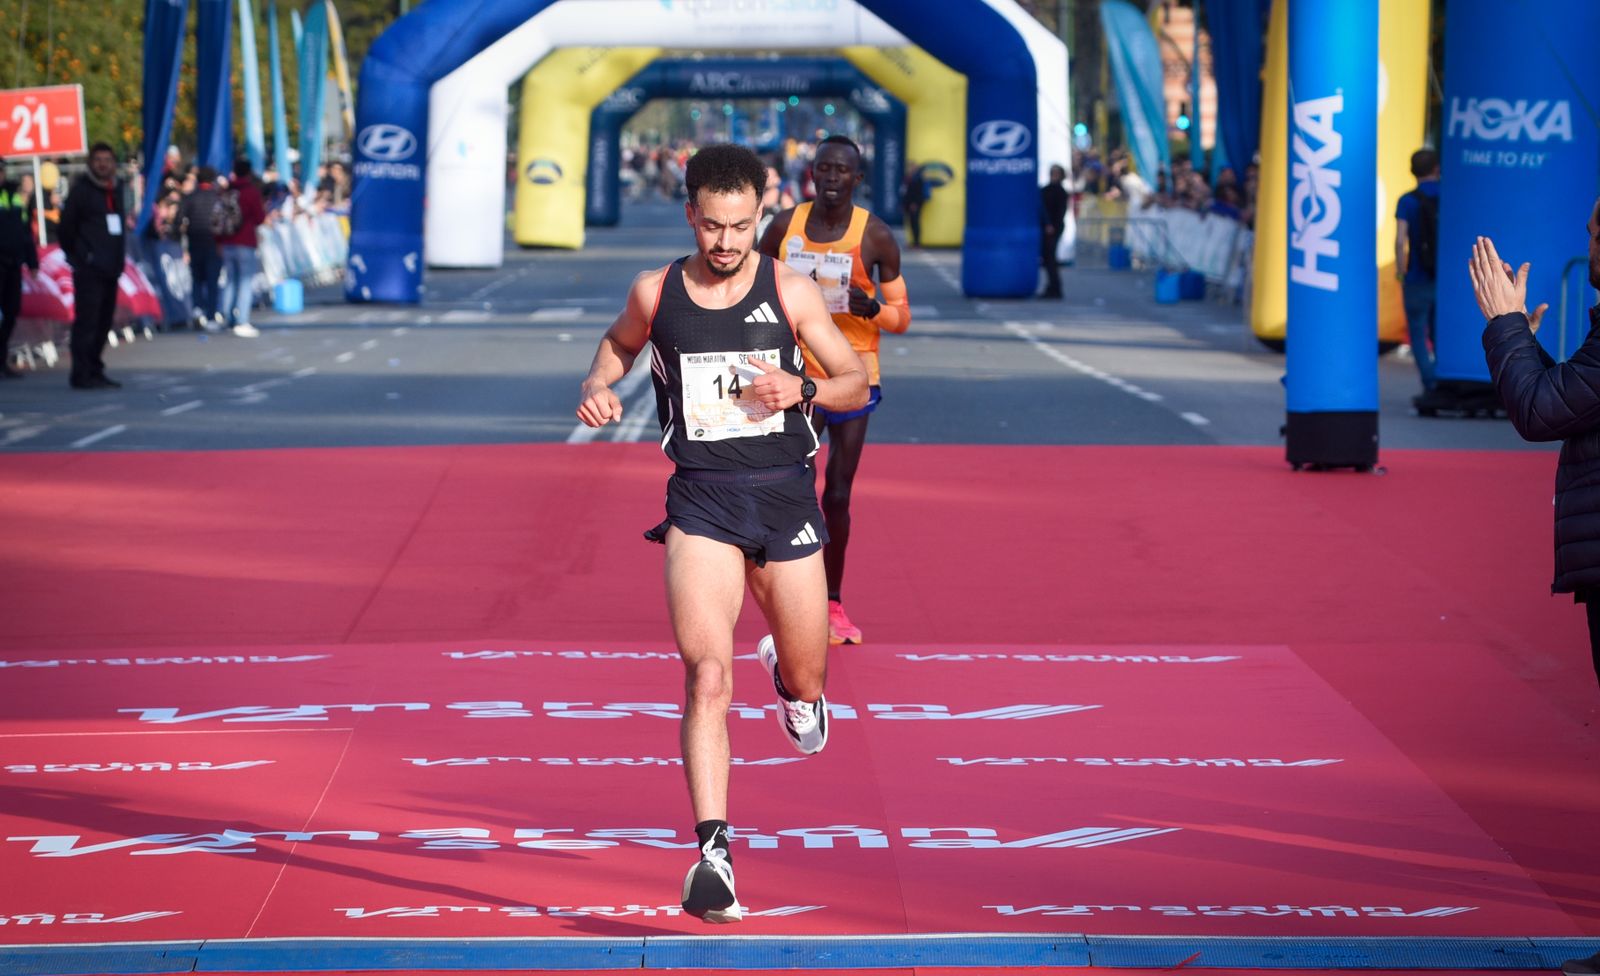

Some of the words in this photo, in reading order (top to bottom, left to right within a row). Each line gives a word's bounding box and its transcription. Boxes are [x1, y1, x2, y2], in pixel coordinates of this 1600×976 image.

[11, 104, 50, 150] 21
[1447, 97, 1573, 142] HOKA
[967, 157, 1035, 175] HYUNDAI
[1463, 150, 1491, 165] TIME
[1497, 152, 1517, 166] TO
[1521, 152, 1546, 167] FLY
[353, 161, 421, 181] HYUNDAI
[1291, 95, 1344, 292] HOKA
[808, 268, 818, 282] 4
[739, 353, 767, 366] SELLA
[713, 374, 742, 400] 14
